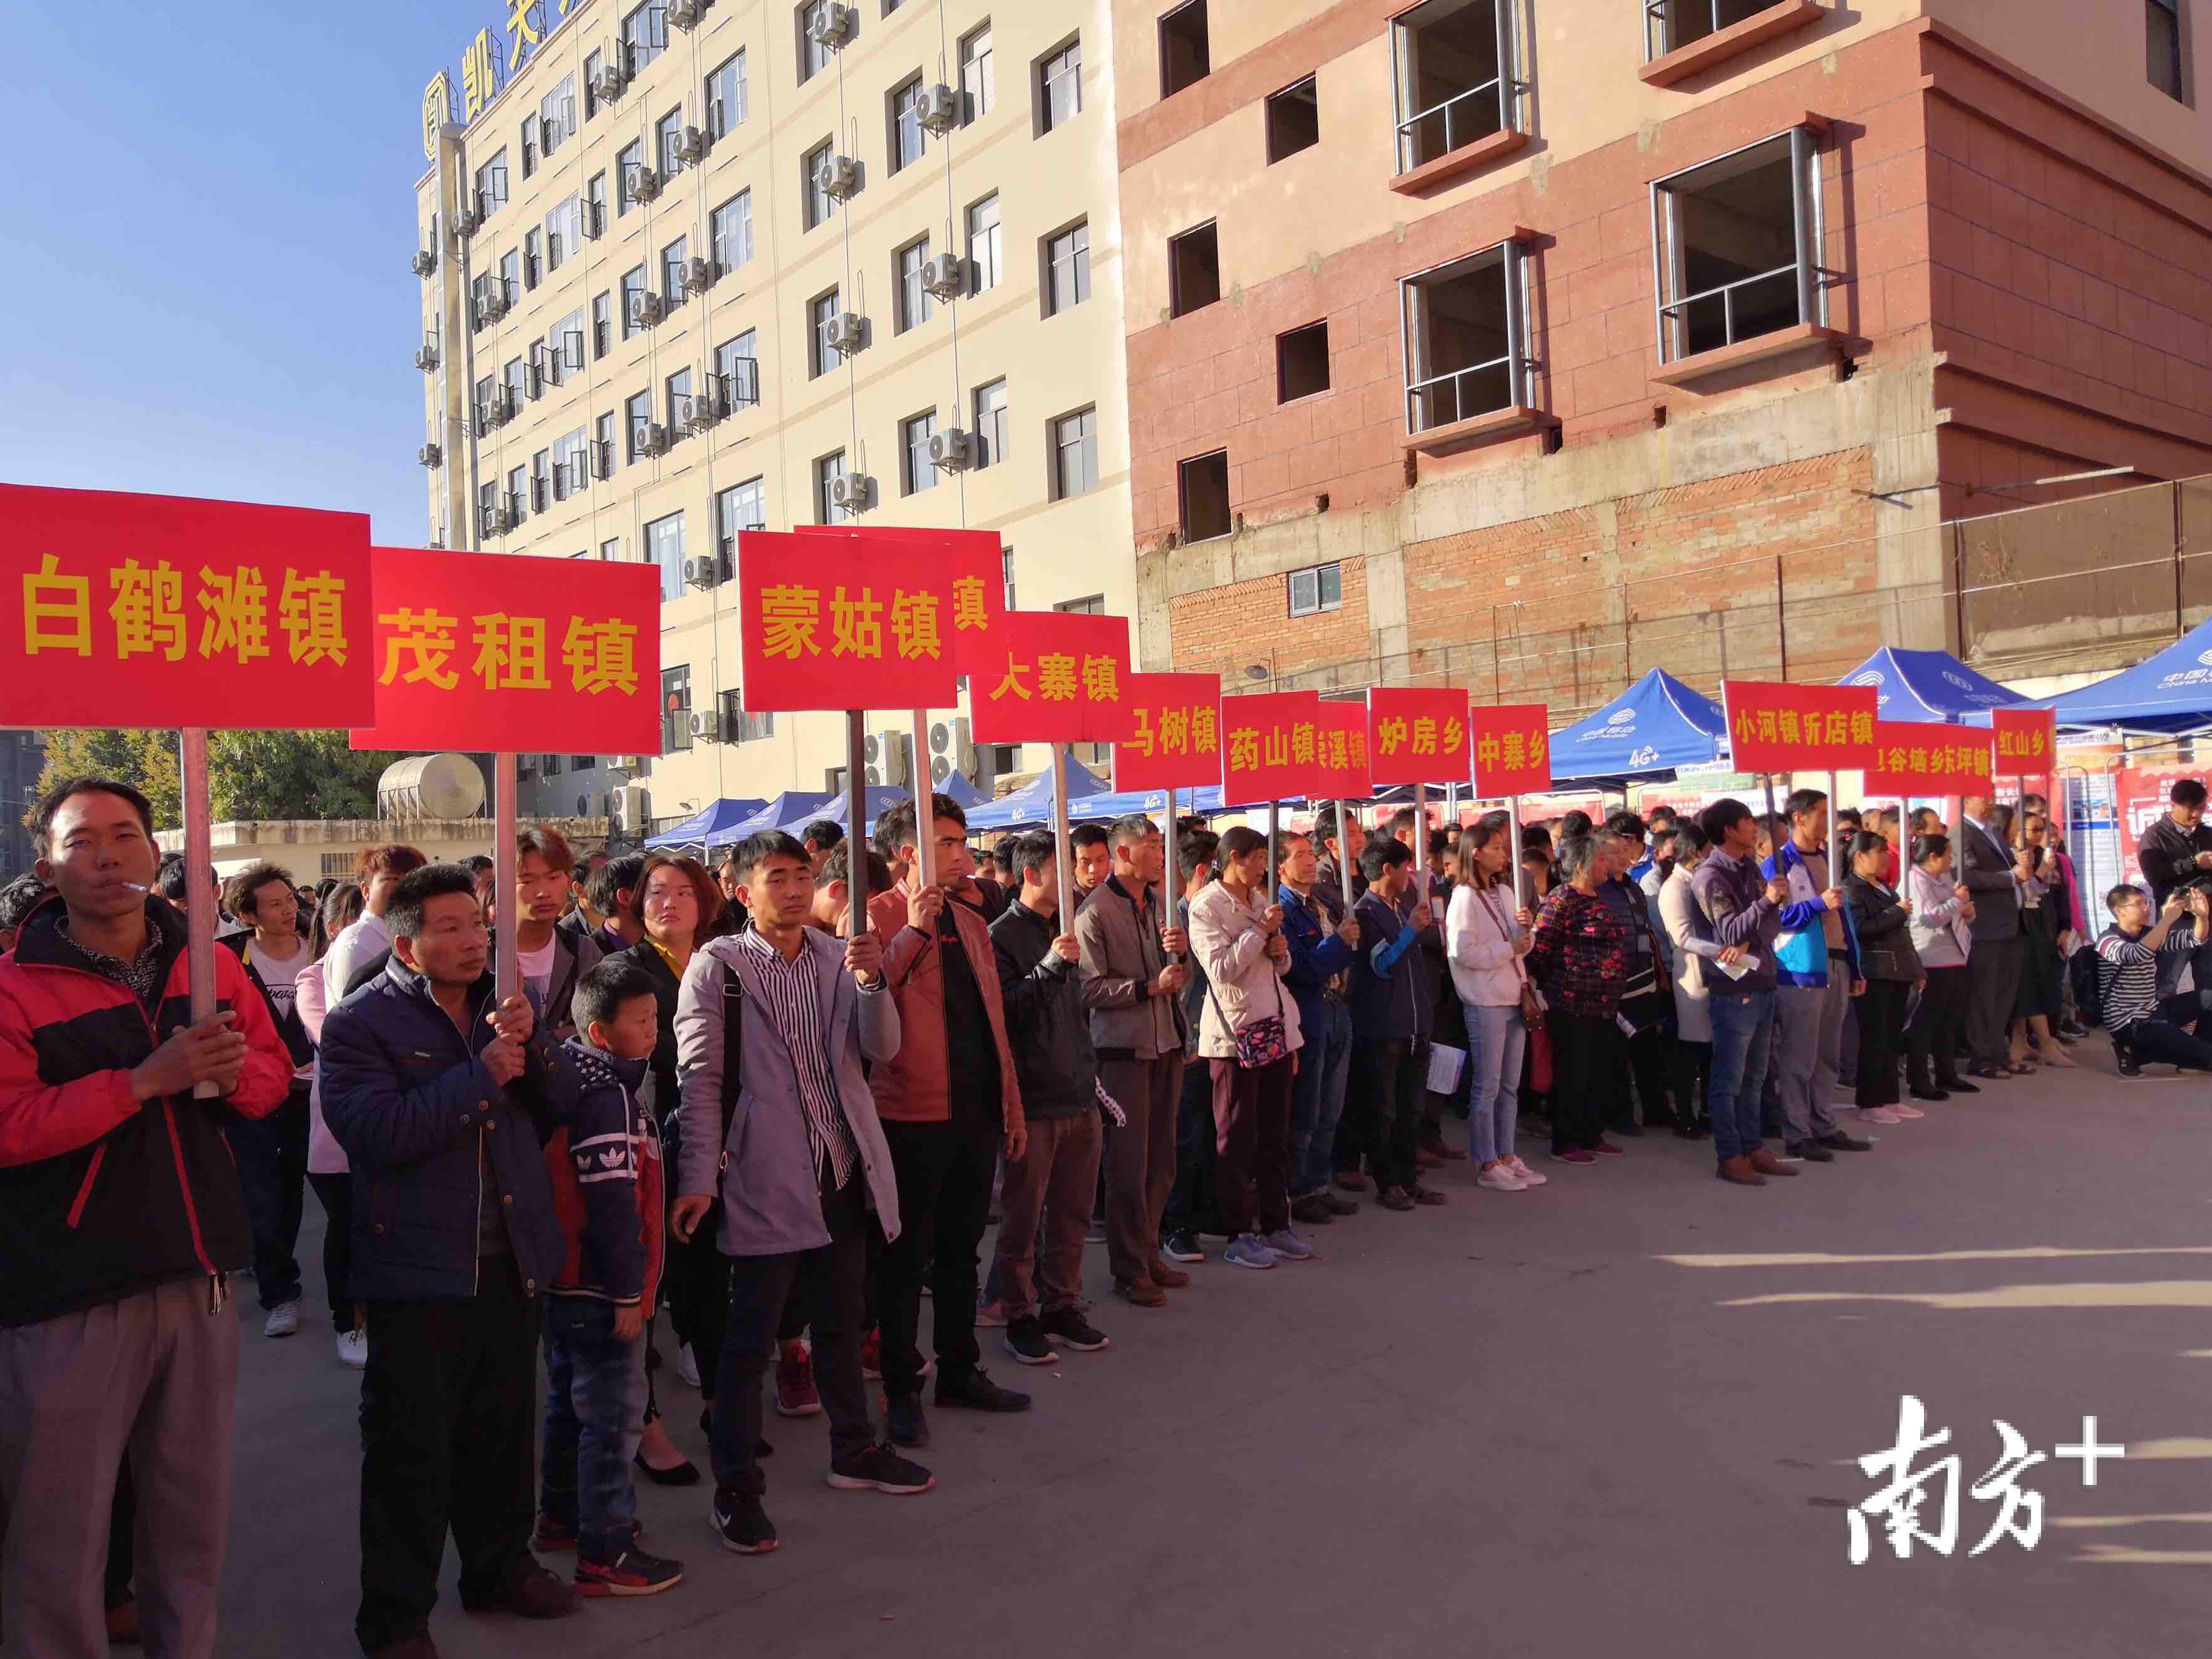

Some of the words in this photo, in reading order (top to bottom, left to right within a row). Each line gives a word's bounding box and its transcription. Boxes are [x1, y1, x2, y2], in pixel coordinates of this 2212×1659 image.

[23, 552, 348, 667] 白鹤滩镇
[760, 584, 941, 661] 蒙姑镇
[378, 607, 639, 696] 茂租镇
[988, 651, 1120, 702] 大寨镇
[1122, 706, 1217, 757] 马树镇
[1228, 721, 1315, 772] 药山镇
[1378, 716, 1464, 755] 炉房乡
[1477, 729, 1546, 773] 中寨乡
[1735, 709, 1801, 745] 小河镇
[1998, 729, 2045, 757] 红山乡
